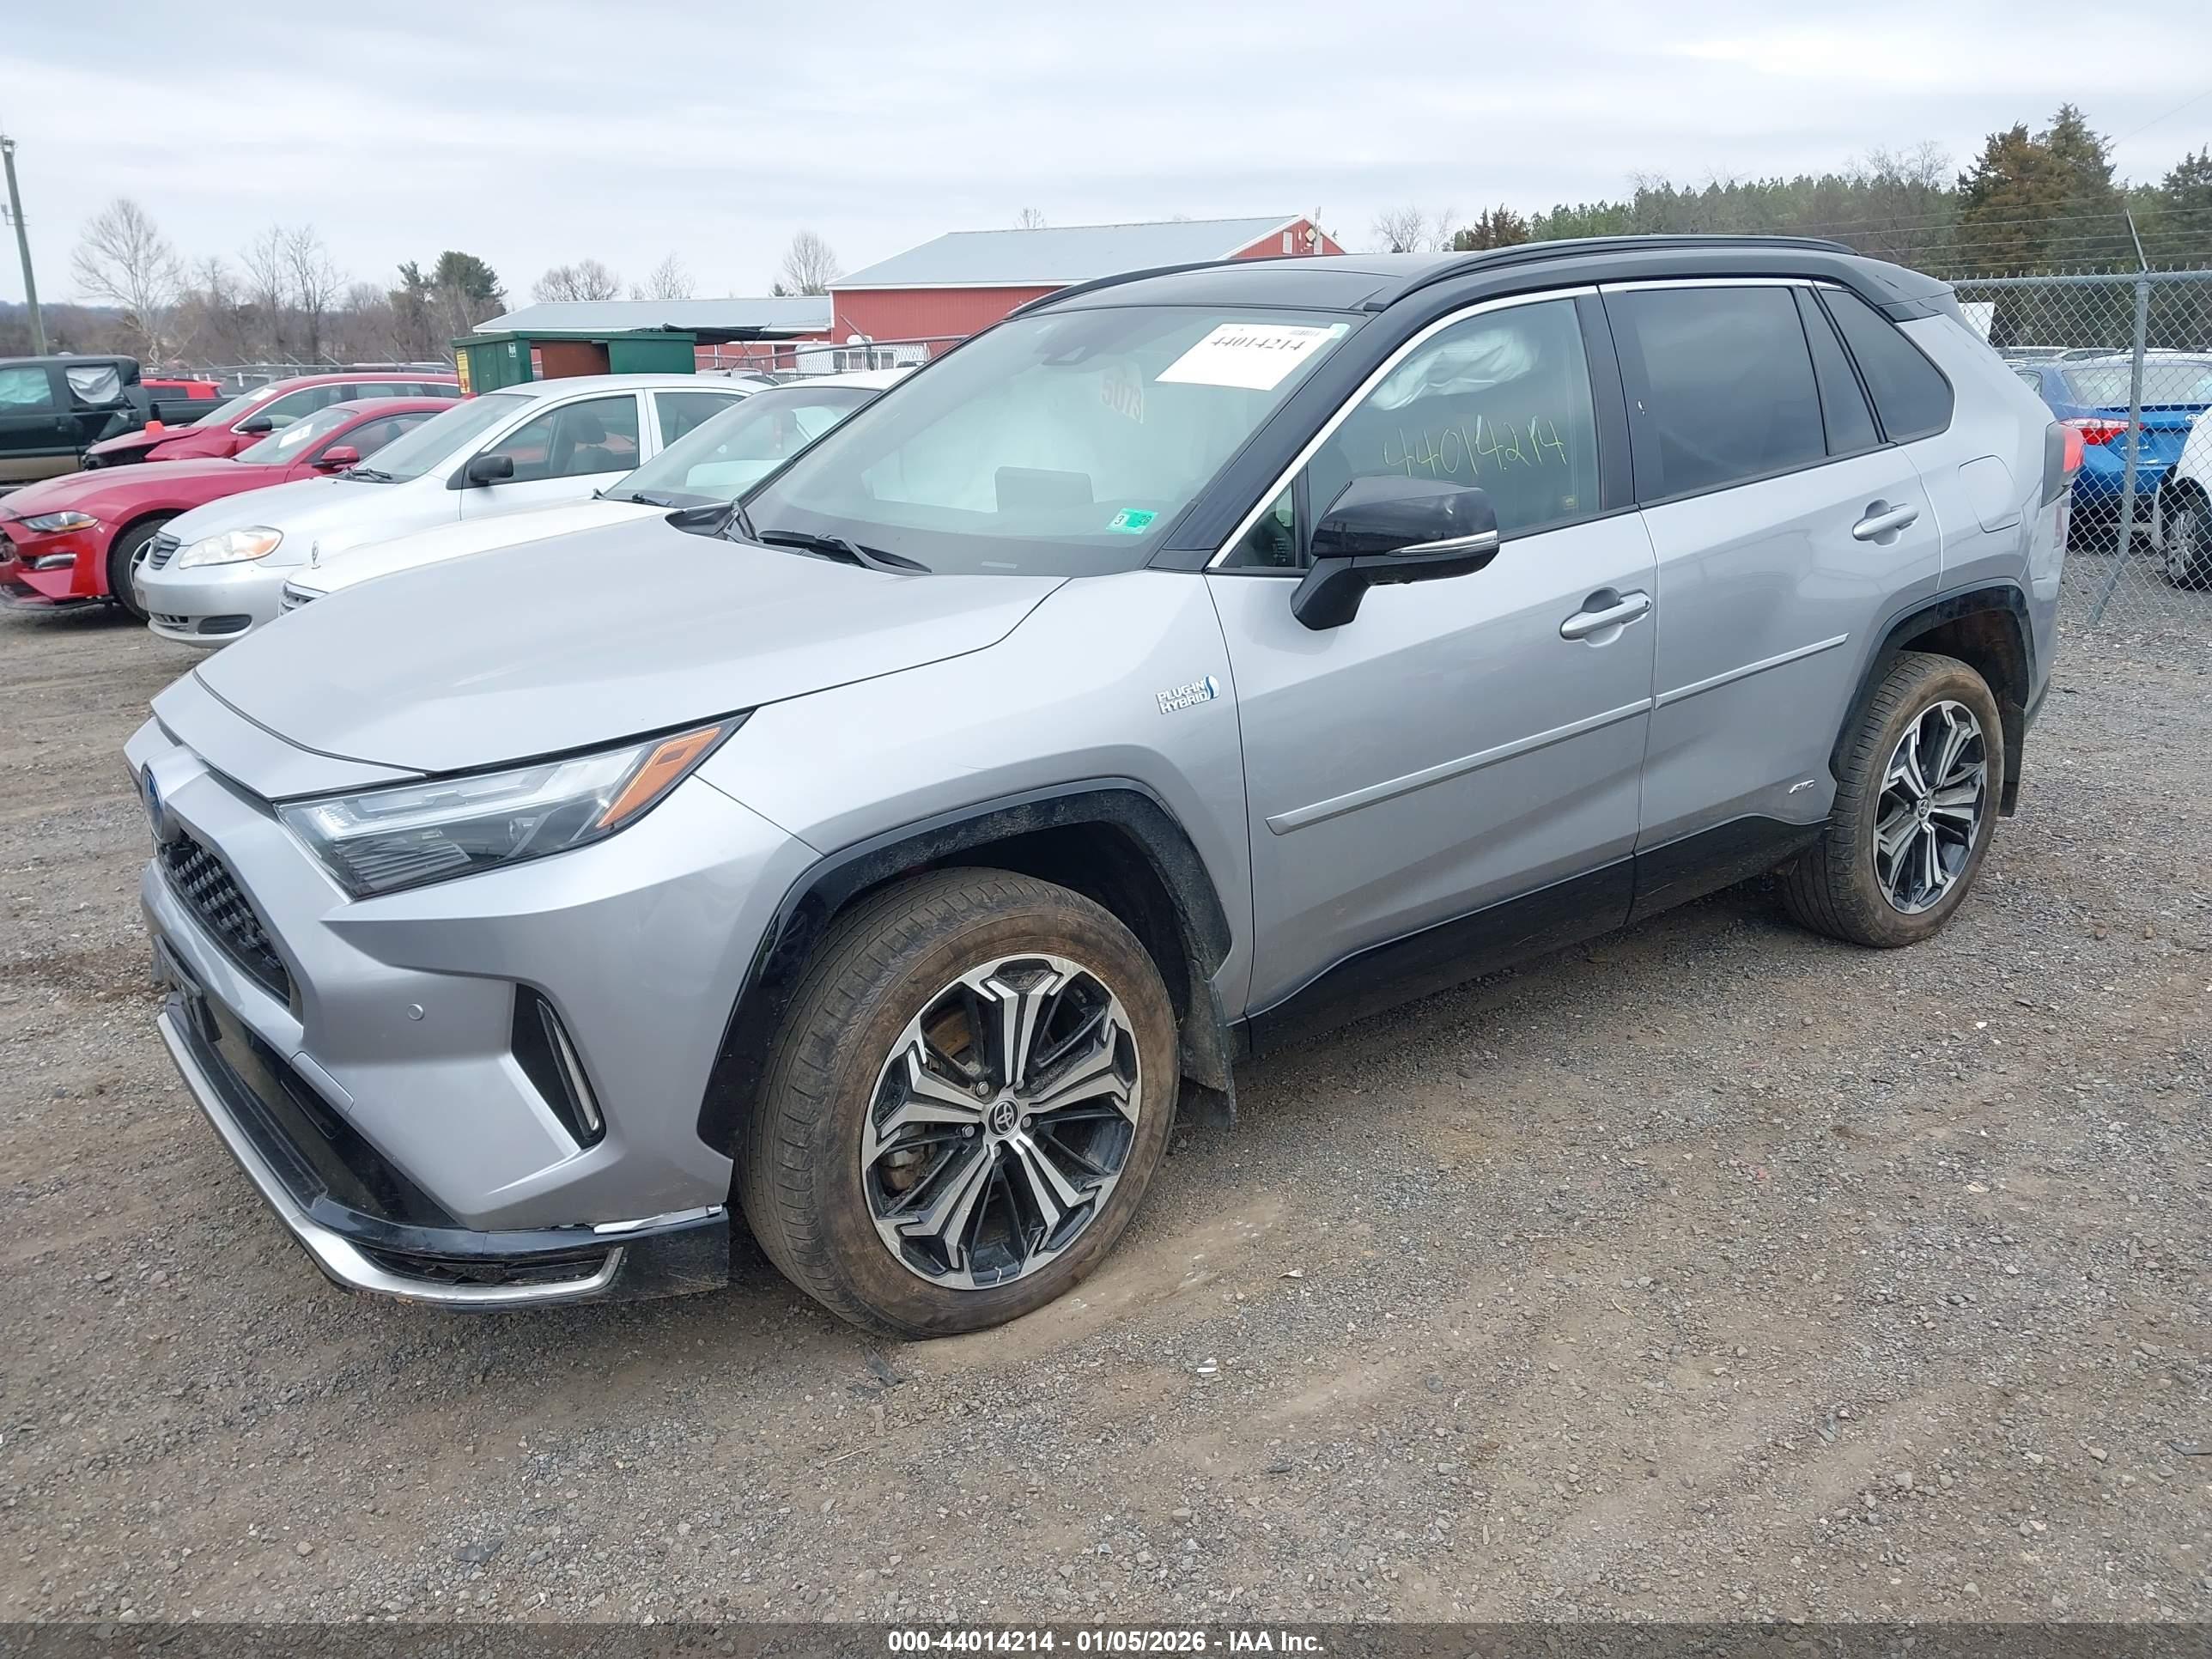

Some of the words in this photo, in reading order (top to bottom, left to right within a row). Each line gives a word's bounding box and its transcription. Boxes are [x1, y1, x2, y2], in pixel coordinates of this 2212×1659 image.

[1211, 336, 1306, 350] 44014214
[1384, 414, 1566, 477] 44014214
[1114, 514, 1125, 526] 3
[1156, 679, 1206, 702] PLUG-IN
[1159, 692, 1209, 714] HYBRID
